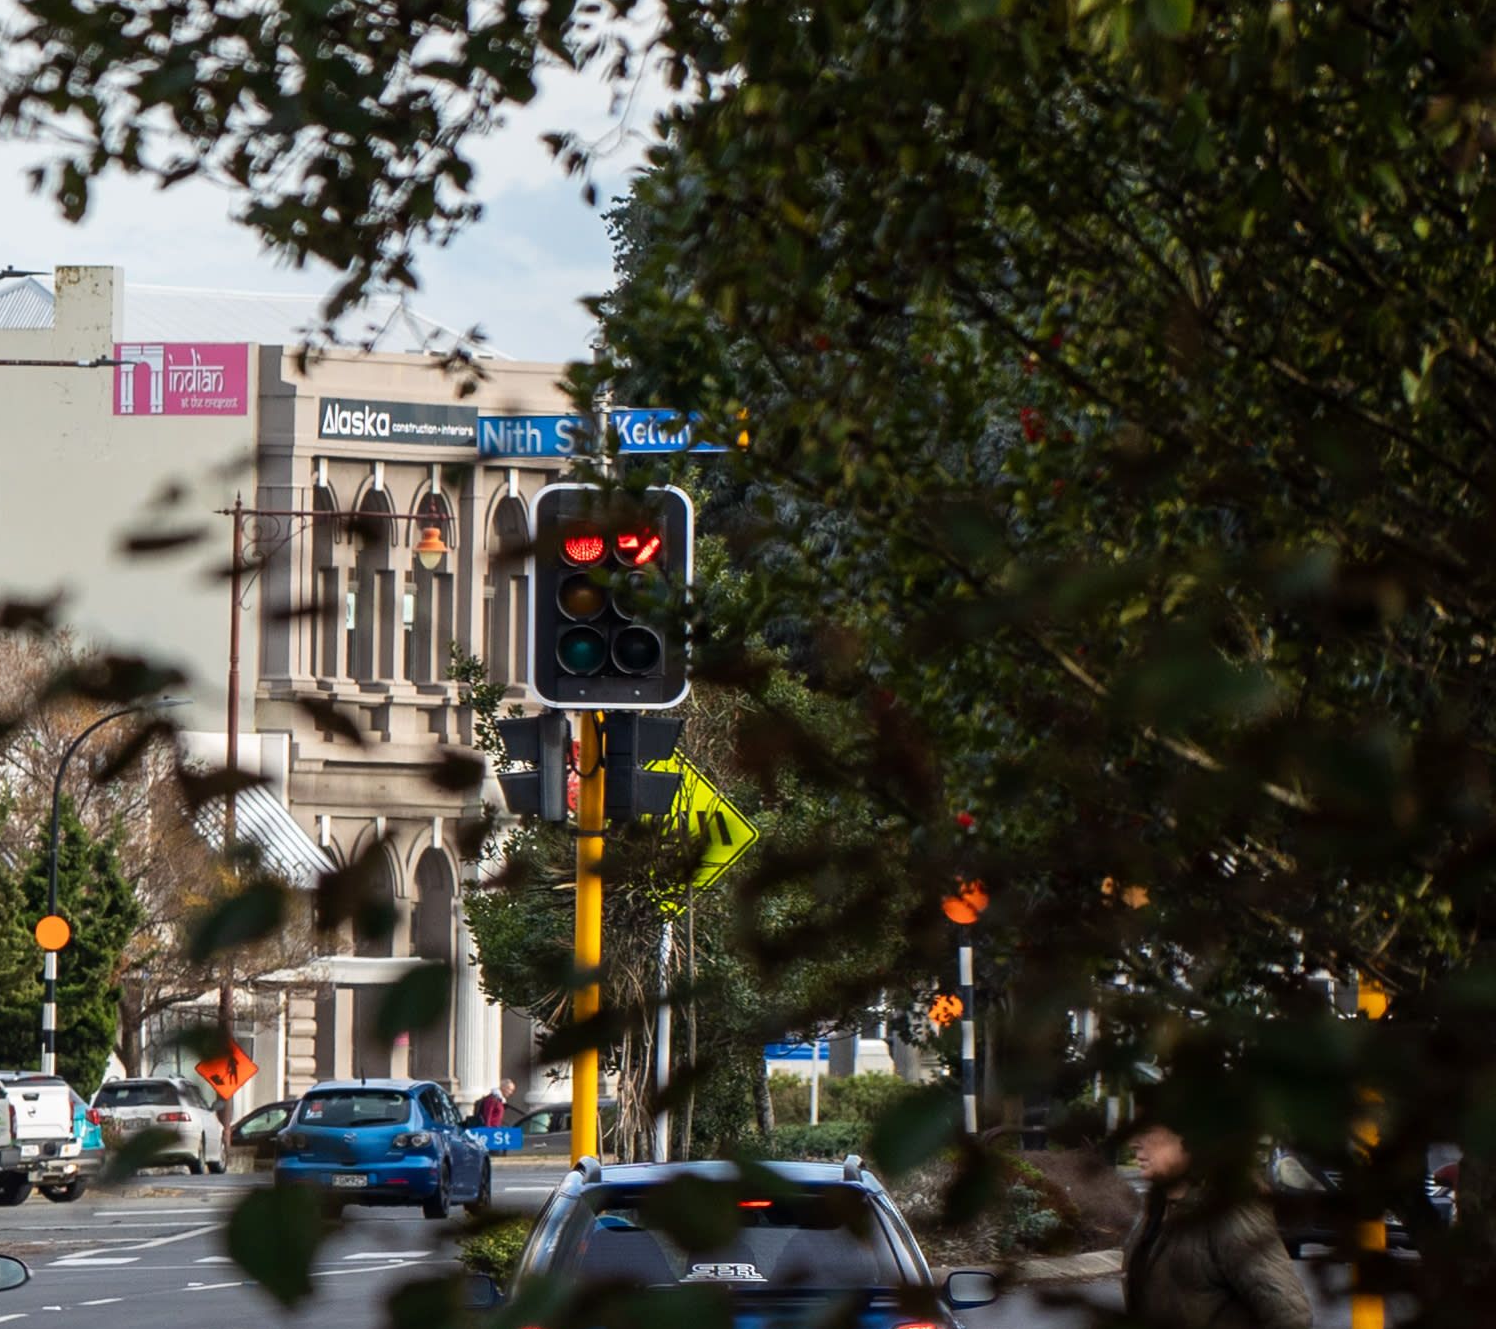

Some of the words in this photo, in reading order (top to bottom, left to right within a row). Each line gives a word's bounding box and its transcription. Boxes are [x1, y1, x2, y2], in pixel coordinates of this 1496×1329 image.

[169, 349, 224, 393] indian
[322, 403, 390, 437] Alaska
[392, 423, 437, 434] construction
[483, 418, 542, 455] Nith
[494, 1130, 511, 1145] St
